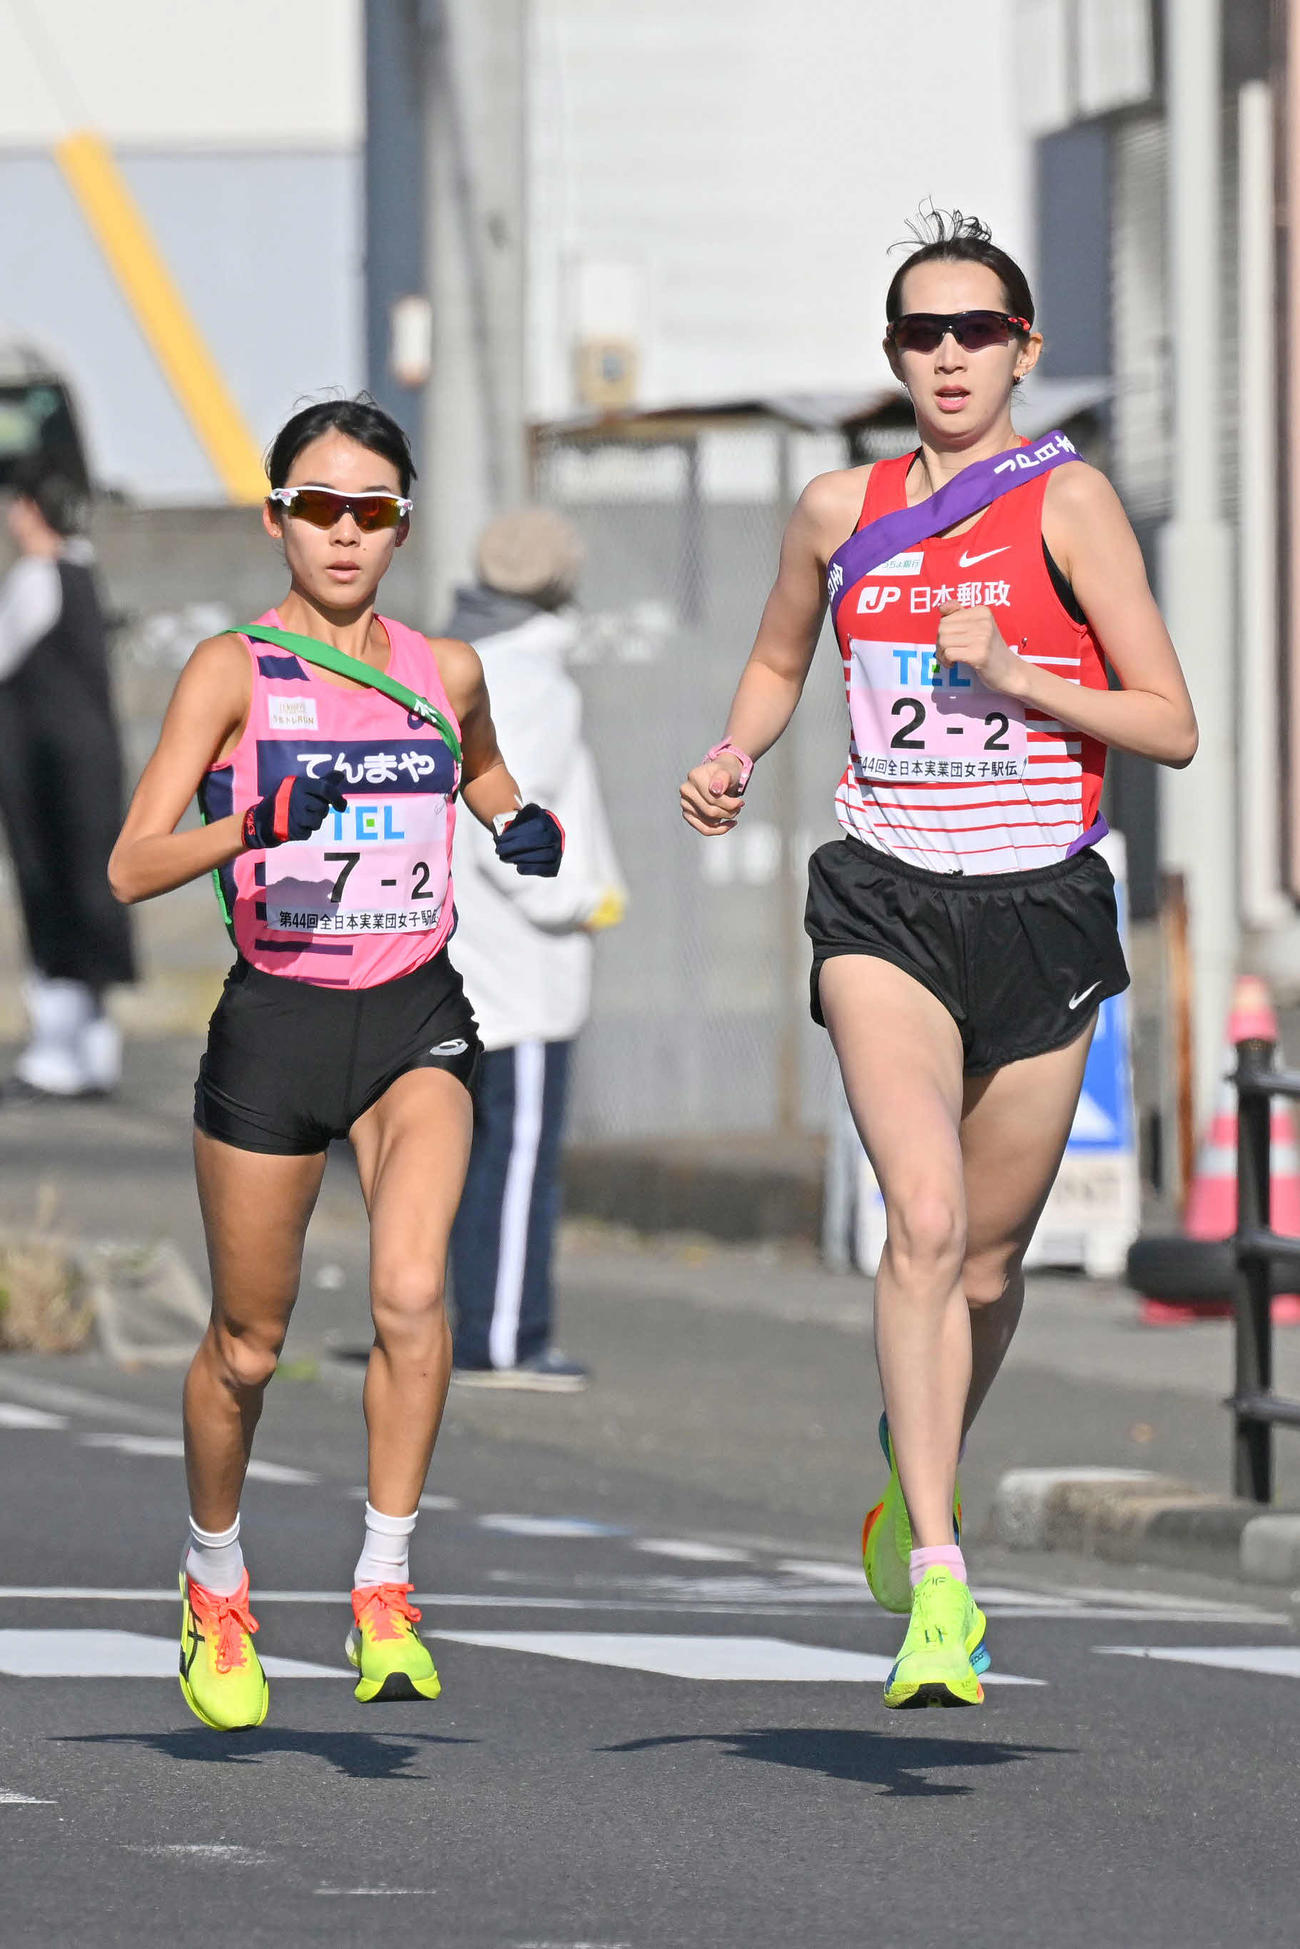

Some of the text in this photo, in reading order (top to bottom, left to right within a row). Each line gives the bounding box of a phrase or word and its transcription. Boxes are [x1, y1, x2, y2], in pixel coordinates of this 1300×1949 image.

[856, 581, 1011, 614] JP 日本郵政
[893, 650, 971, 687] TEL
[296, 751, 435, 784] てんまや
[860, 756, 1018, 778] 44回全日本実業団女子駅伝
[327, 805, 405, 841] TEL
